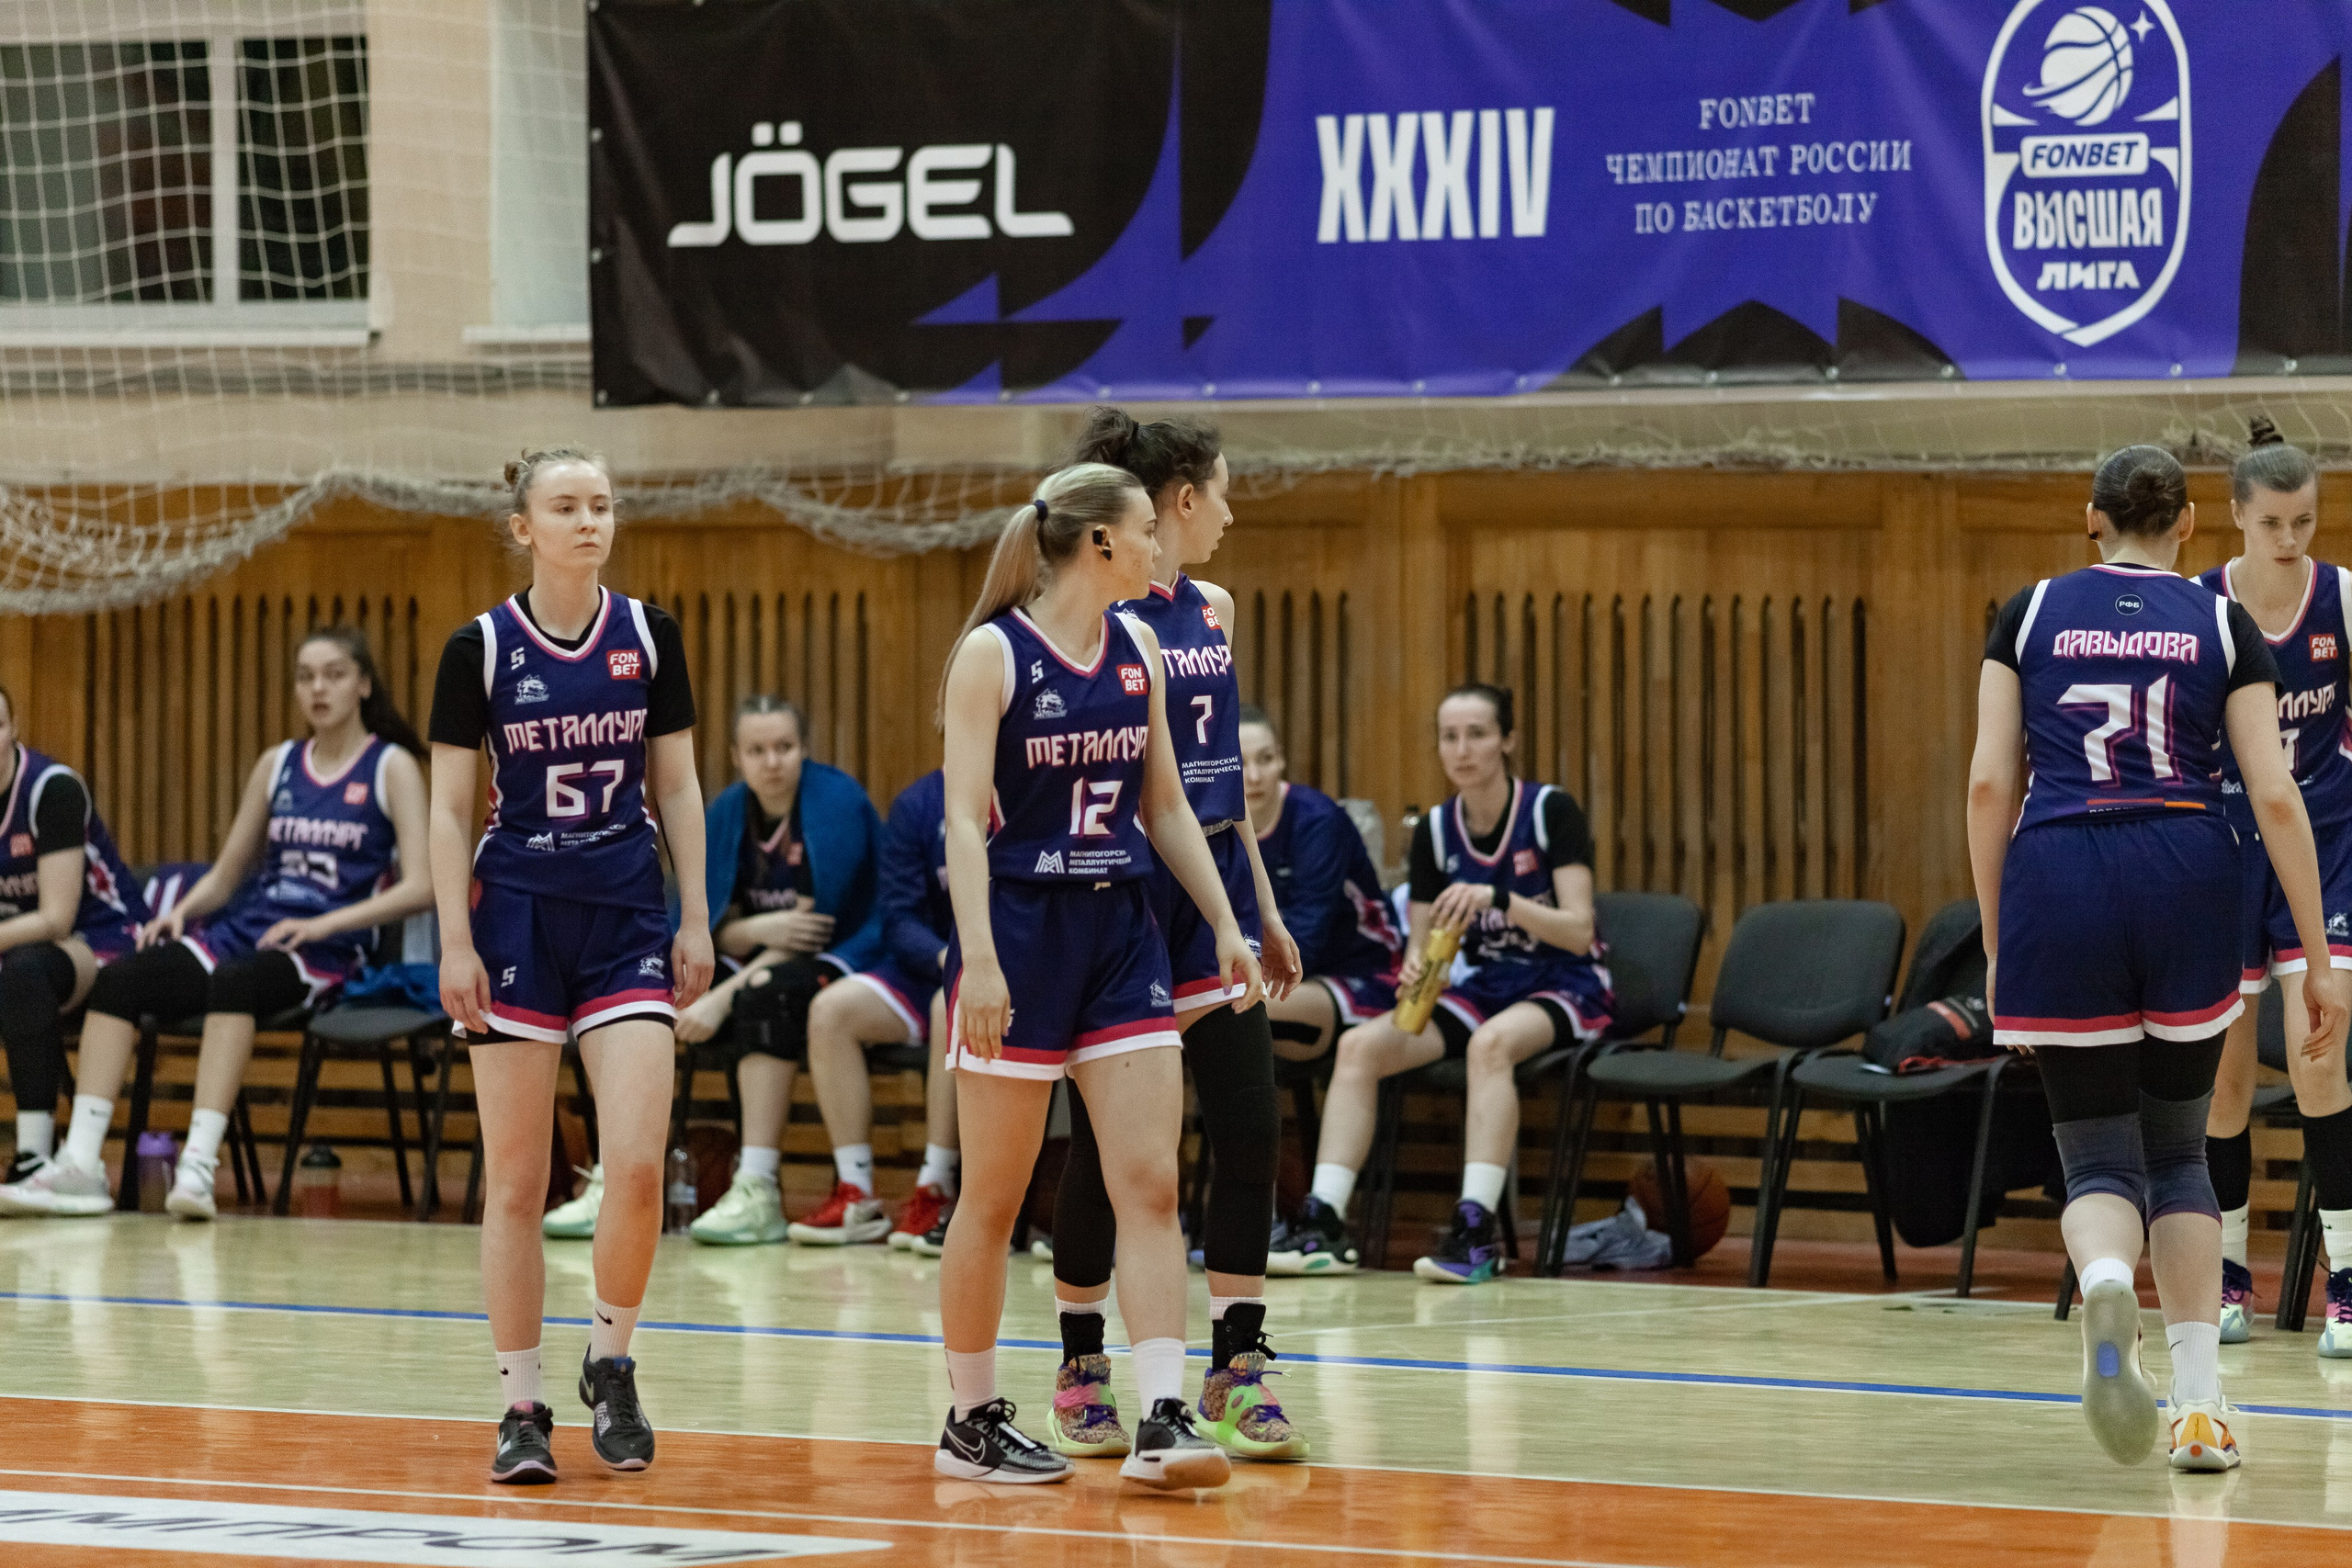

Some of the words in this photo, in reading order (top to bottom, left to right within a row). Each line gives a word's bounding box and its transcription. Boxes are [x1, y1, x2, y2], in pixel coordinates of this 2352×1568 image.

[1699, 93, 1815, 130] FONBET
[1605, 145, 1780, 186] ЧЕМПИОНАТ
[1789, 139, 1913, 175] РОССИИ
[2030, 141, 2140, 169] FONBET
[667, 121, 1074, 247] JÖGEL
[1316, 107, 1555, 243] XXXIV
[1634, 201, 1676, 234] ПО
[1682, 192, 1879, 232] БАСКЕТБОЛУ
[2012, 187, 2164, 250] ВЫСШАЯ
[2036, 261, 2141, 291] ЛИГА
[1203, 606, 1215, 618] FO
[1206, 617, 1220, 627] BE
[609, 652, 639, 665] FON
[2052, 629, 2199, 663] ДАВЫДОВА
[2311, 636, 2335, 647] FON
[2312, 646, 2336, 659] BET
[612, 663, 640, 676] BET
[1120, 666, 1143, 679] FON
[1160, 645, 1233, 679] ТАЛЛУР
[1125, 678, 1145, 691] BET
[1190, 694, 1213, 745] 7
[2056, 672, 2176, 782] 71
[546, 760, 625, 818] 67
[1069, 776, 1124, 836] 12
